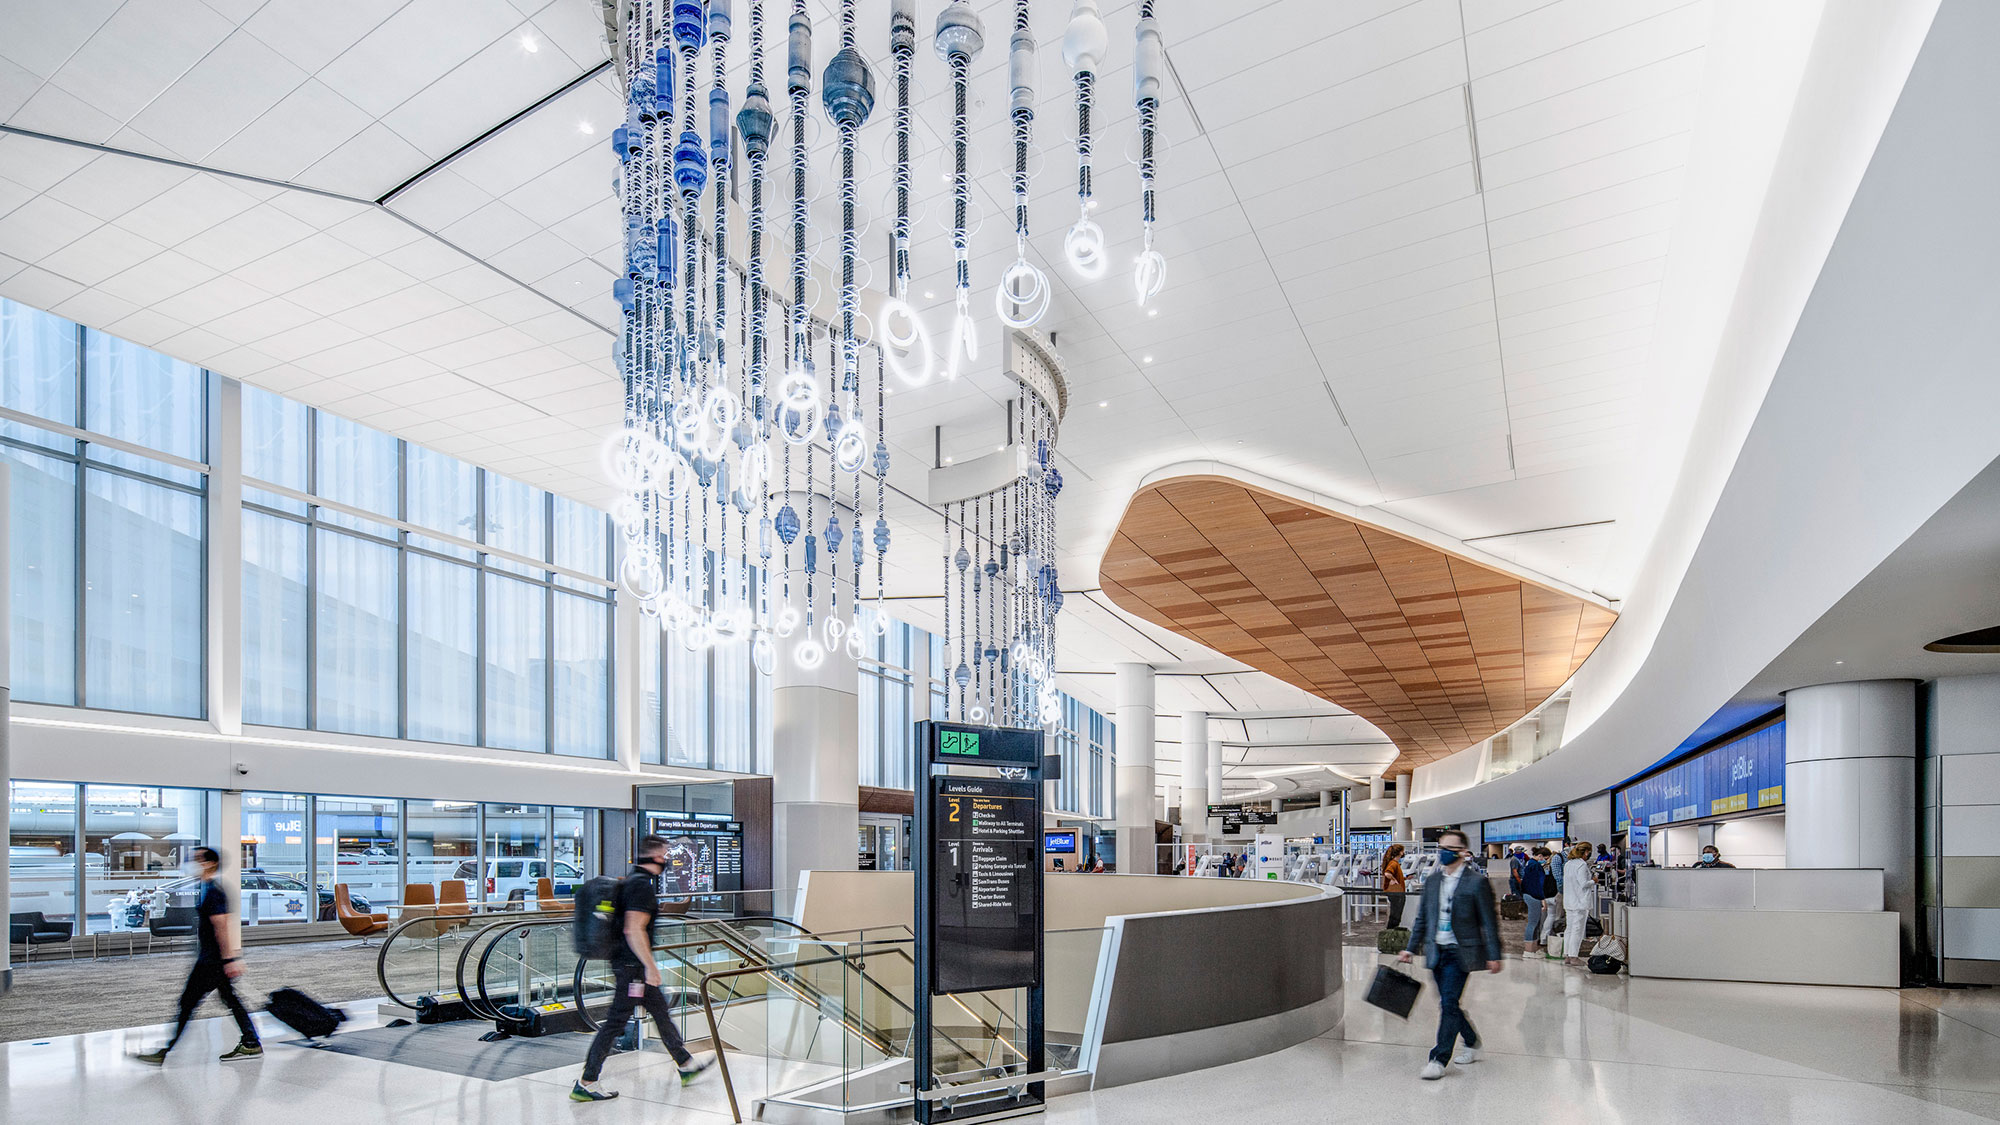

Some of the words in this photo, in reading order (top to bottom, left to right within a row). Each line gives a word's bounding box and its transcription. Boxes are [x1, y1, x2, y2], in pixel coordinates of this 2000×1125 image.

[1732, 755, 1753, 787] jetBlue
[949, 803, 960, 822] 2
[1050, 838, 1070, 846] jetBlue
[950, 847, 958, 866] 1
